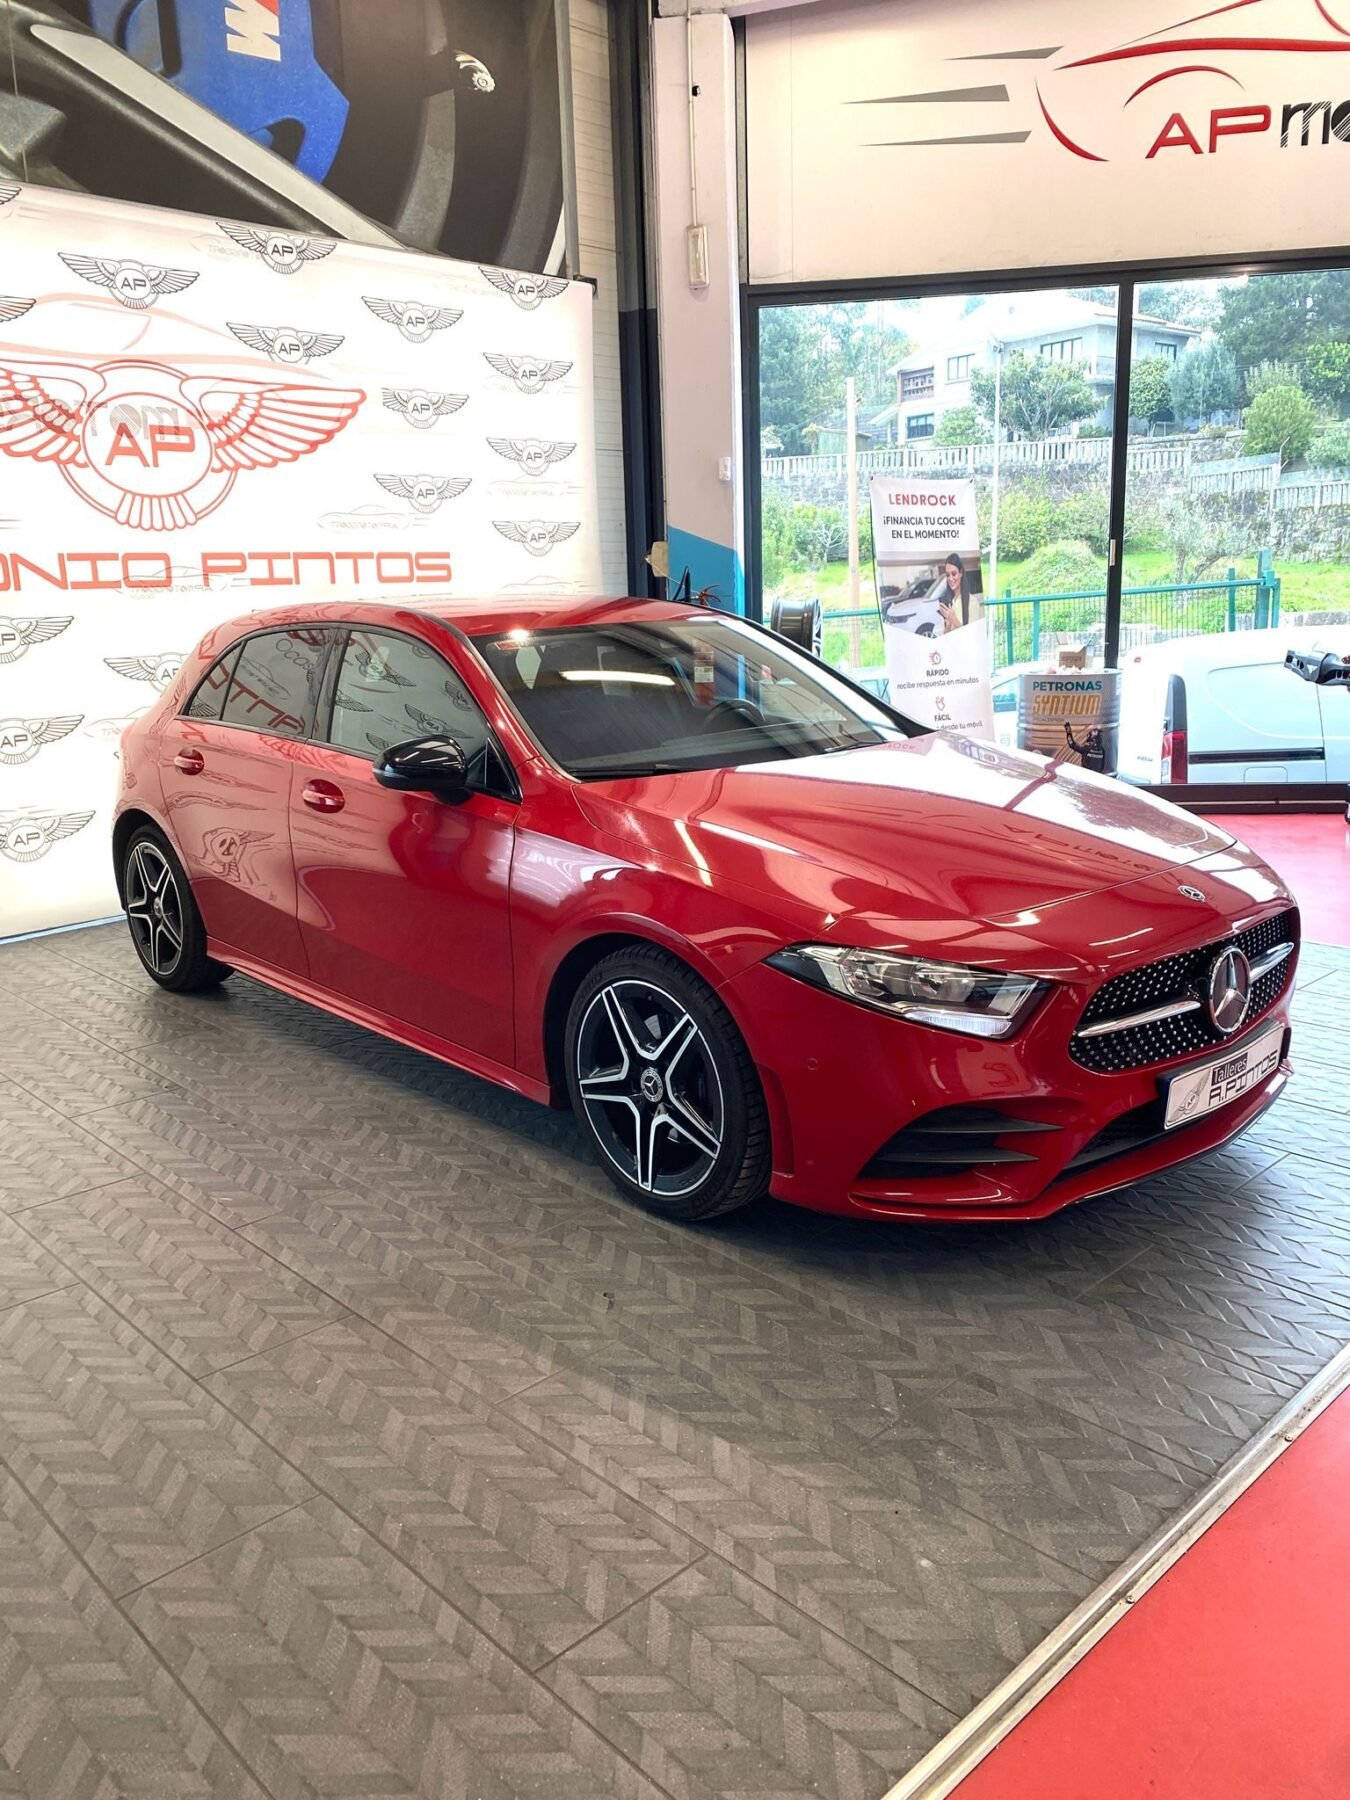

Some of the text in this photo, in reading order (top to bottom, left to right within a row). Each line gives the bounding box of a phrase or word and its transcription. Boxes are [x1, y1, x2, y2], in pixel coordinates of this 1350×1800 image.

[270, 243, 294, 257] AP
[120, 277, 147, 291] AP
[517, 284, 535, 295] AP
[405, 315, 425, 327] AP
[278, 342, 300, 355] AP
[520, 369, 538, 380] AP
[412, 402, 431, 414] AP
[105, 423, 195, 468] AP
[525, 450, 543, 461] AP
[416, 488, 435, 499] AP
[888, 493, 956, 506] LENDROCK
[924, 517, 935, 525] TU
[936, 516, 965, 525] COCHE
[530, 532, 547, 542] AP
[891, 530, 960, 539] EN EL MOMENTO!
[0, 552, 452, 591] NIO PINTOS
[0, 633, 16, 646] P
[896, 682, 916, 690] recibe
[916, 679, 946, 689] respuesta
[955, 677, 979, 685] minutos
[1032, 681, 1102, 692] PETRONAS
[1032, 694, 1102, 716] SYNTIUM
[0, 734, 28, 748] AP
[13, 831, 42, 846] AP
[1213, 1056, 1248, 1084] Talleres
